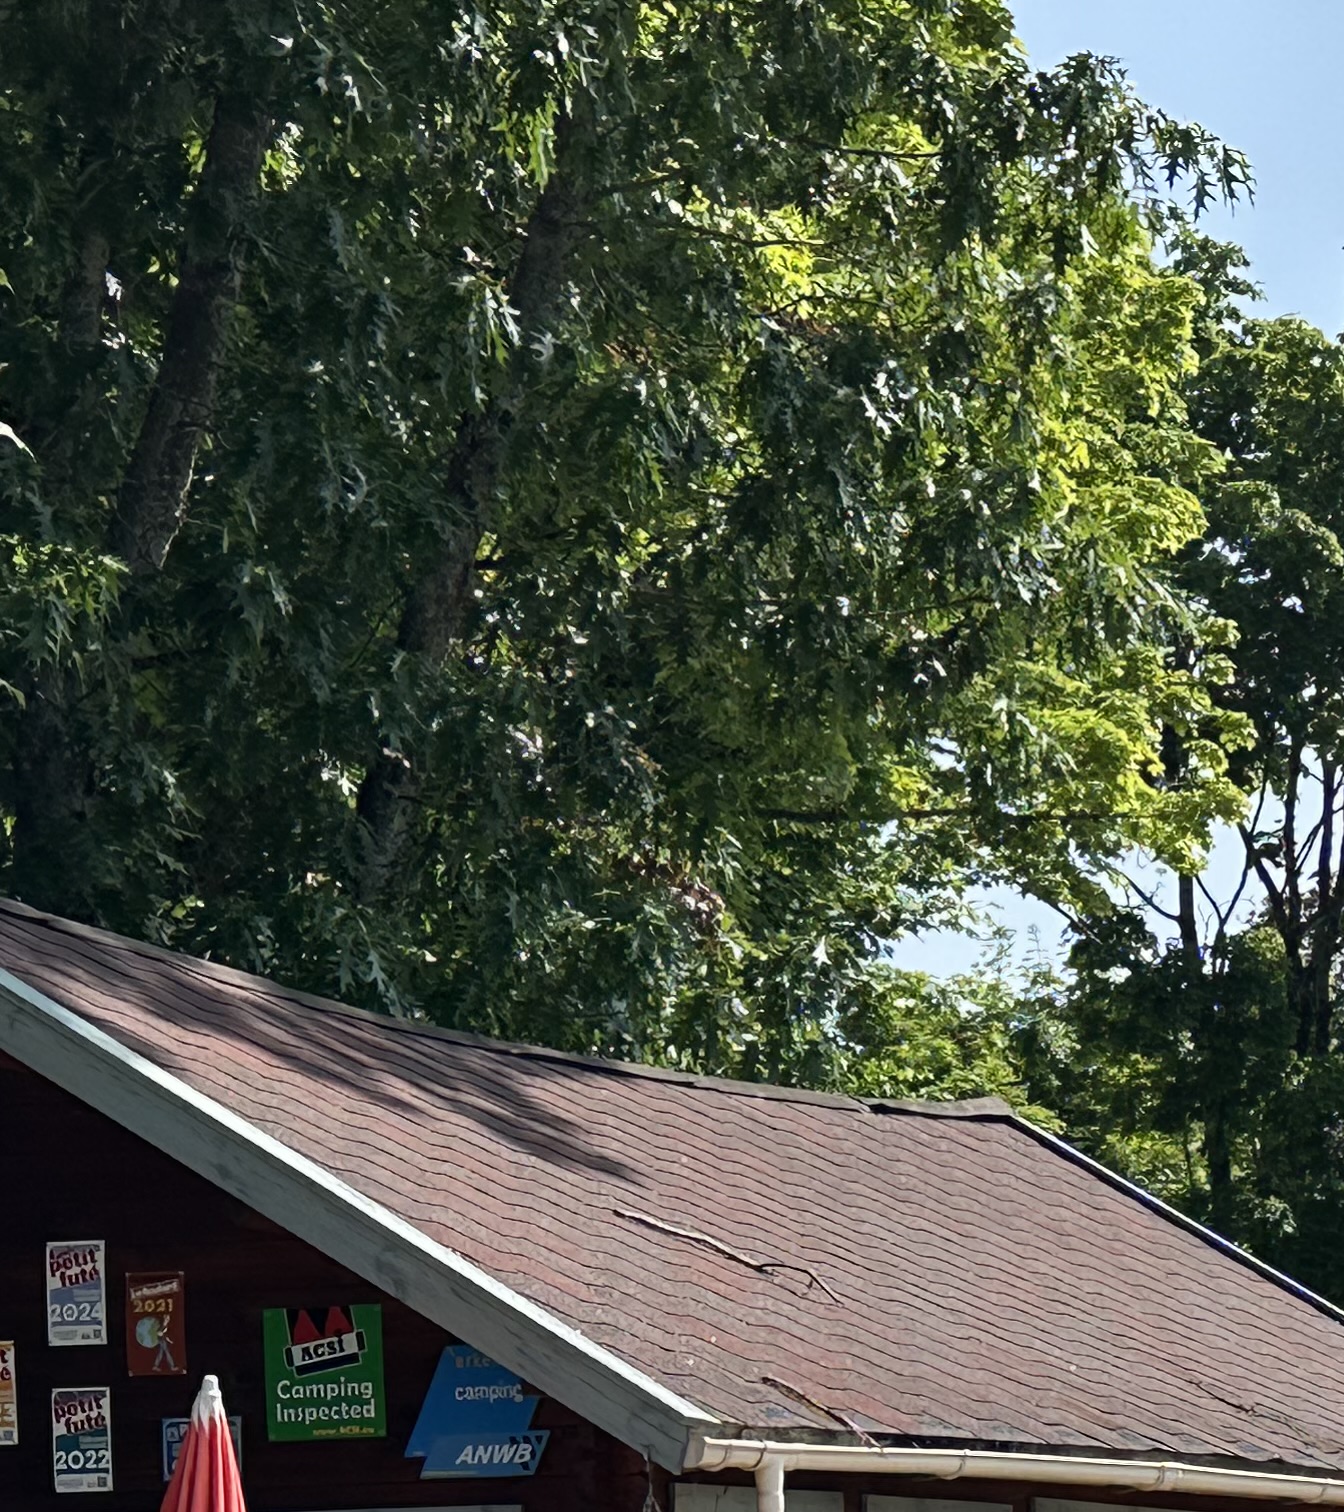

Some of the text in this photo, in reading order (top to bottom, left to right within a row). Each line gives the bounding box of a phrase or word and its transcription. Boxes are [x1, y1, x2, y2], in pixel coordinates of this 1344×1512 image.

[133, 1299, 173, 1313] 2021
[277, 1377, 373, 1400] Camping
[455, 1383, 524, 1403] camping
[276, 1398, 375, 1425] Inspected
[56, 1450, 109, 1469] 2022
[455, 1443, 532, 1465] ANWB
